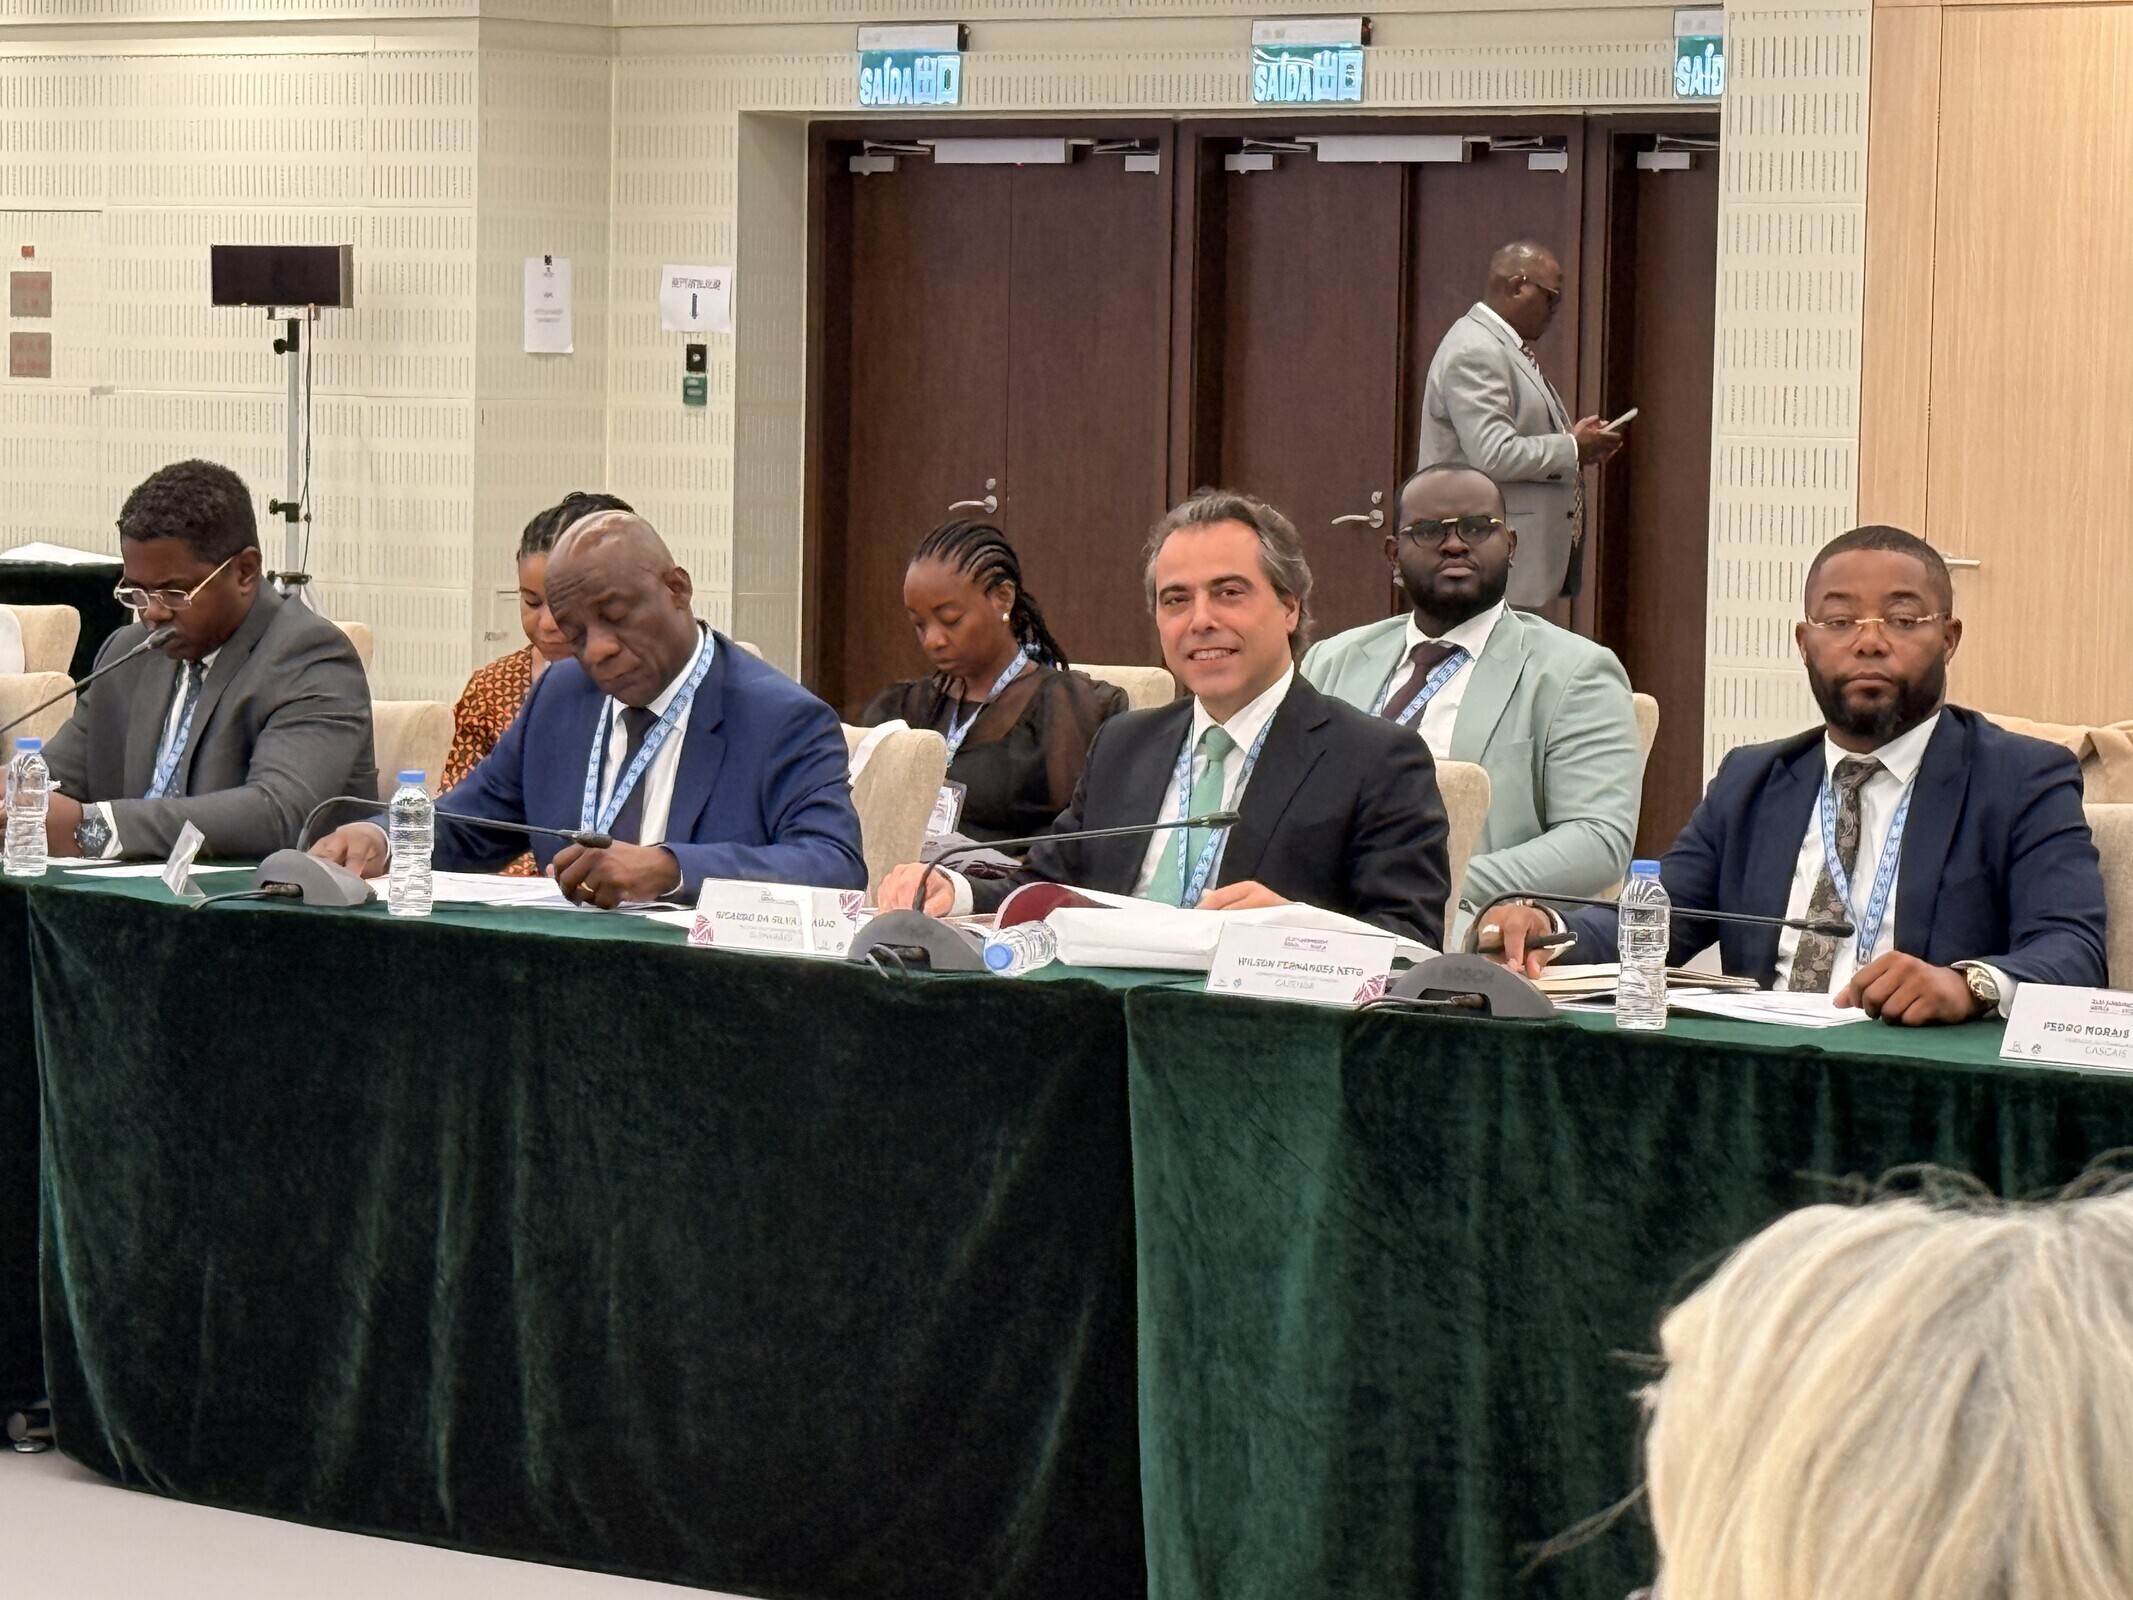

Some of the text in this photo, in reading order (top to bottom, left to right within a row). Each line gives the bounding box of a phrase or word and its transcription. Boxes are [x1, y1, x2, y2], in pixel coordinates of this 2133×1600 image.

[1254, 51, 1313, 102] SAÍDA
[1676, 43, 1724, 96] SAÍD
[860, 56, 914, 105] SAÍDA
[757, 913, 769, 923] DA
[772, 915, 797, 926] SILVA
[1238, 957, 1275, 968] WILSON
[1276, 960, 1335, 974] FERNANDES
[1336, 966, 1364, 977] NETO
[2043, 1021, 2130, 1039] PEDRO MORAIS
[2085, 1045, 2127, 1058] CASCAIS
